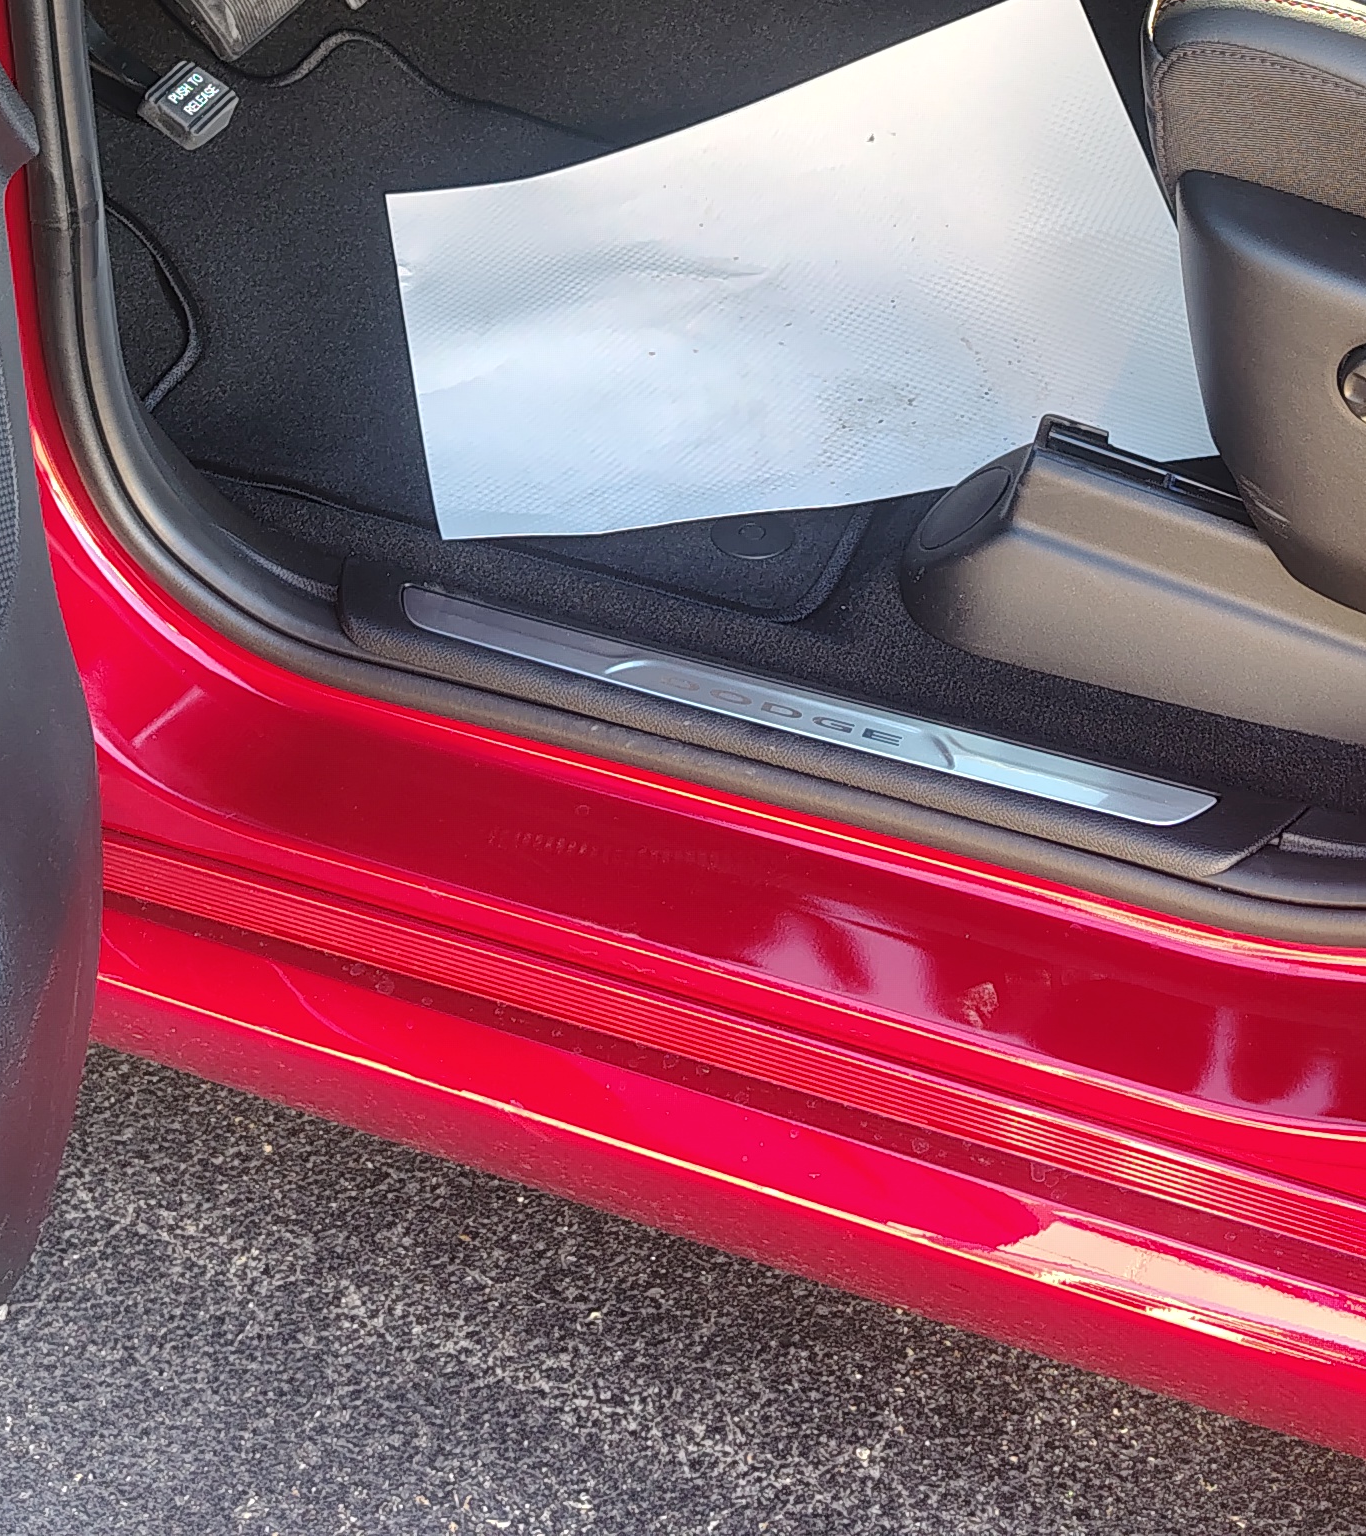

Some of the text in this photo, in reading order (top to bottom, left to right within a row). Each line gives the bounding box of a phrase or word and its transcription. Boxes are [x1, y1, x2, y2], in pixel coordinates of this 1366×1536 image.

[167, 72, 204, 105] PUSH TO
[182, 83, 220, 117] RELEASE
[657, 672, 905, 749] DODGE
